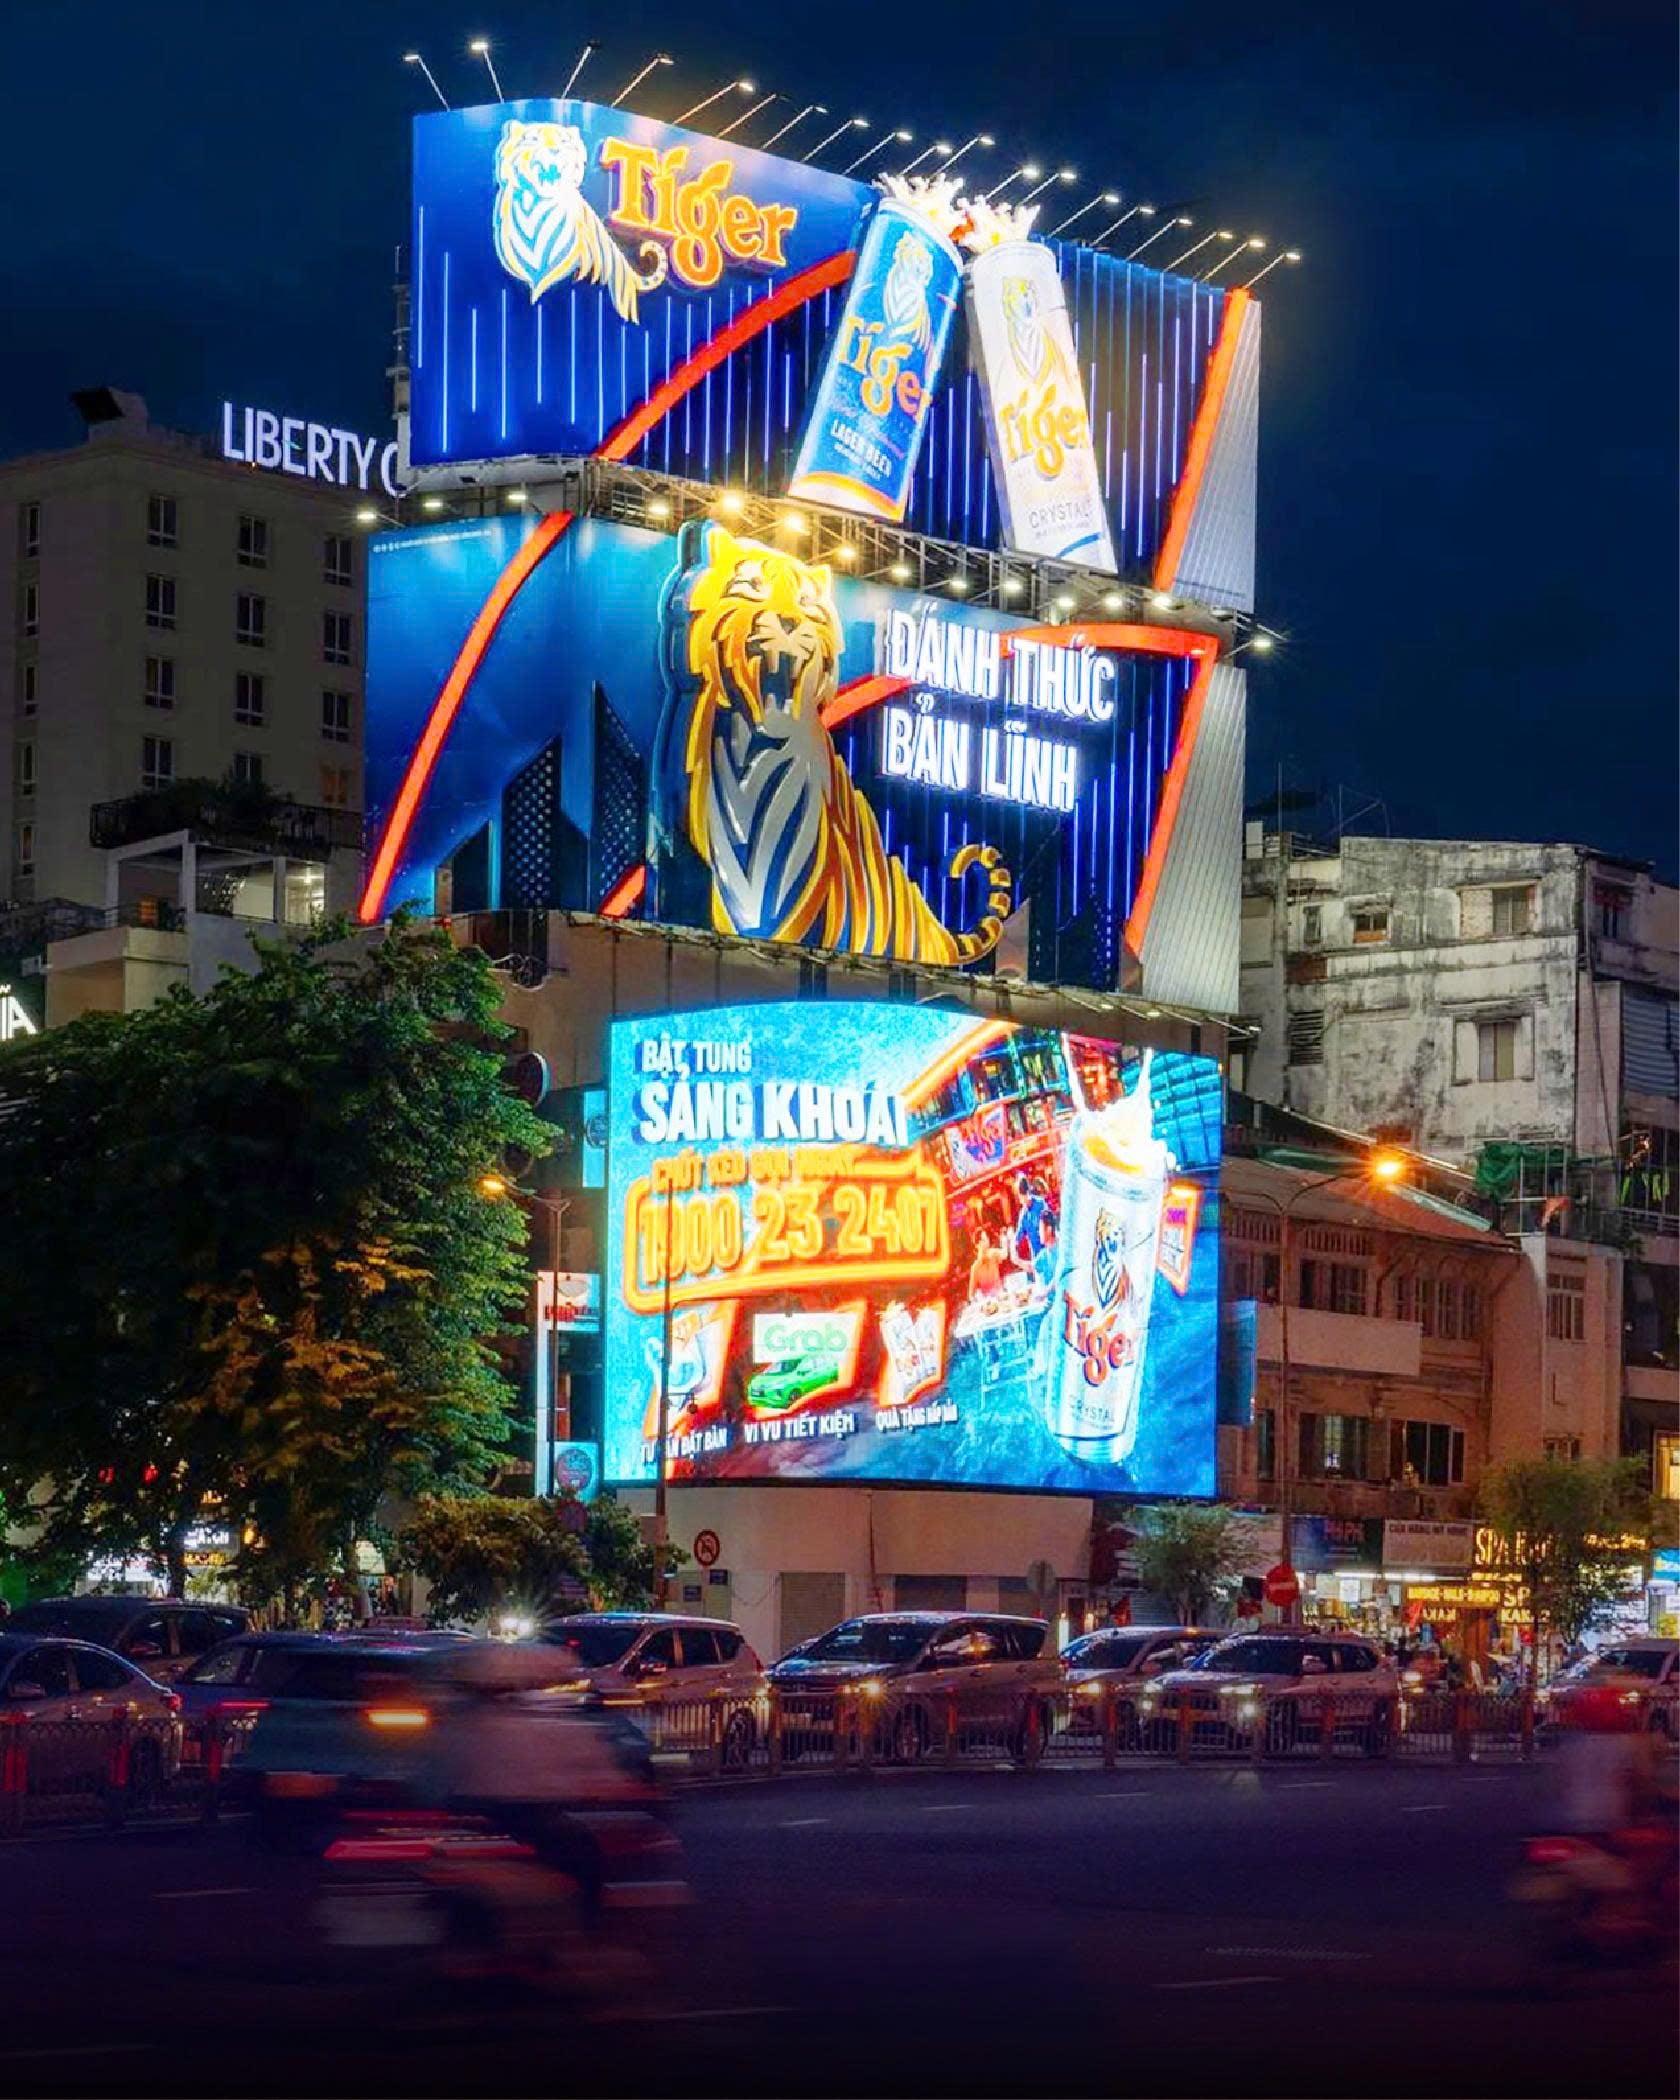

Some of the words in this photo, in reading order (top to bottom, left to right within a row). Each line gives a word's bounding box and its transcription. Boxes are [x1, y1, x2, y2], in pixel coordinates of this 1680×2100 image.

[601, 136, 797, 286] Tiger
[224, 401, 376, 490] LIBERTY
[1029, 502, 1090, 528] CRYSTAL
[885, 600, 999, 700] ĐÁNH
[1008, 634, 1115, 722] THỨC
[882, 693, 969, 791] BẢN
[981, 720, 1078, 812] LĨNH
[763, 1078, 908, 1147] KHOÁI
[753, 1181, 823, 1260] 23
[833, 1184, 938, 1257] 2407
[764, 1322, 848, 1353] Grab
[744, 1423, 759, 1443] VI
[762, 1421, 781, 1441] VU
[784, 1410, 818, 1439] TIẾT
